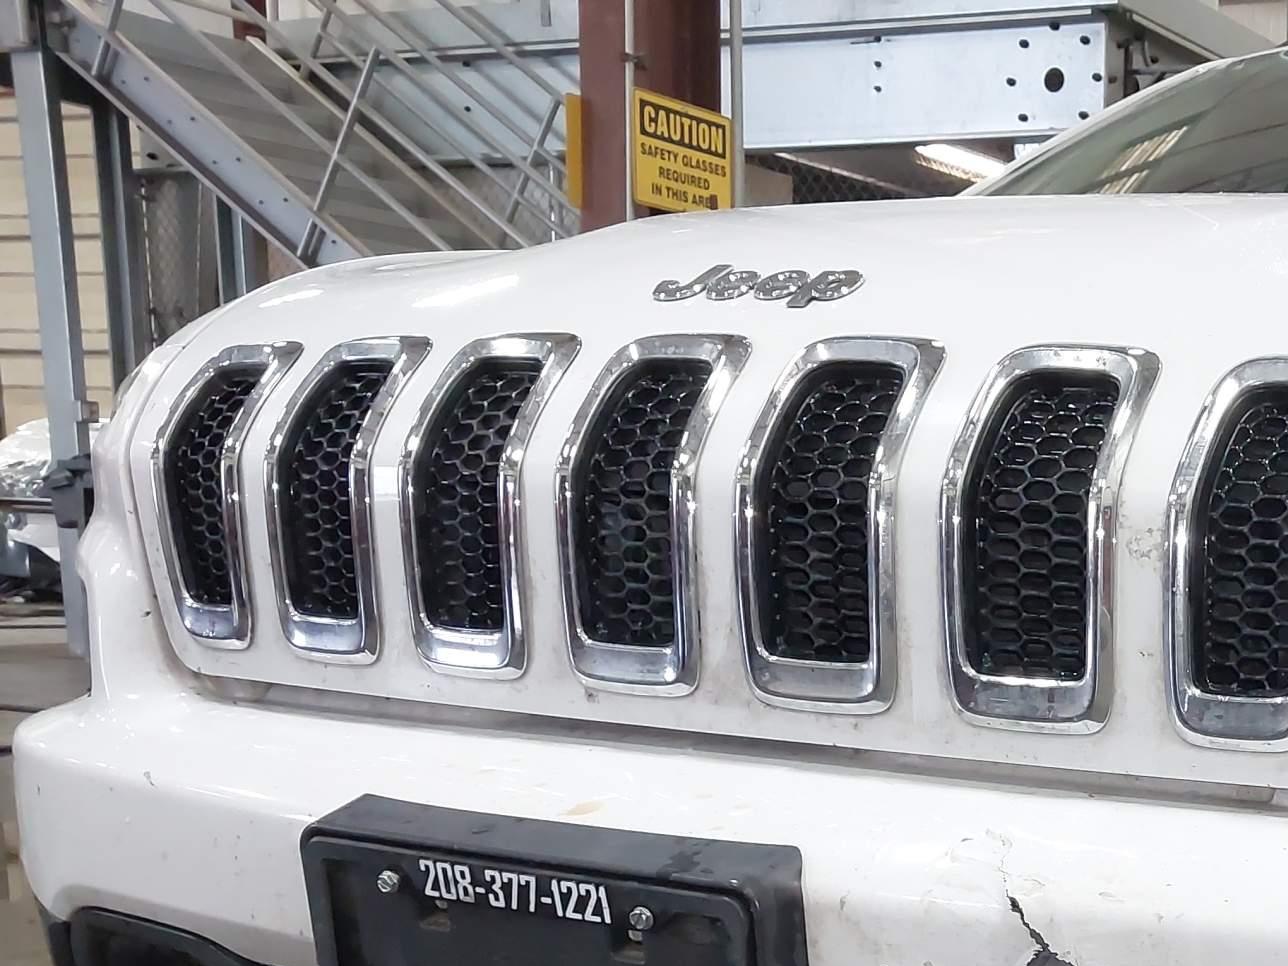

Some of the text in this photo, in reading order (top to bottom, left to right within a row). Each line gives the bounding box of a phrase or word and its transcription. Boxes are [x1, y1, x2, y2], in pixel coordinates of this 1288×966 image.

[643, 105, 724, 154] CAUTION
[640, 142, 727, 178] SAFETY GLASSES
[658, 166, 710, 191] REQUIRED
[651, 182, 718, 210] IN THIS ARE
[652, 264, 866, 308] Jeep
[418, 858, 613, 925] 208-377-1221
